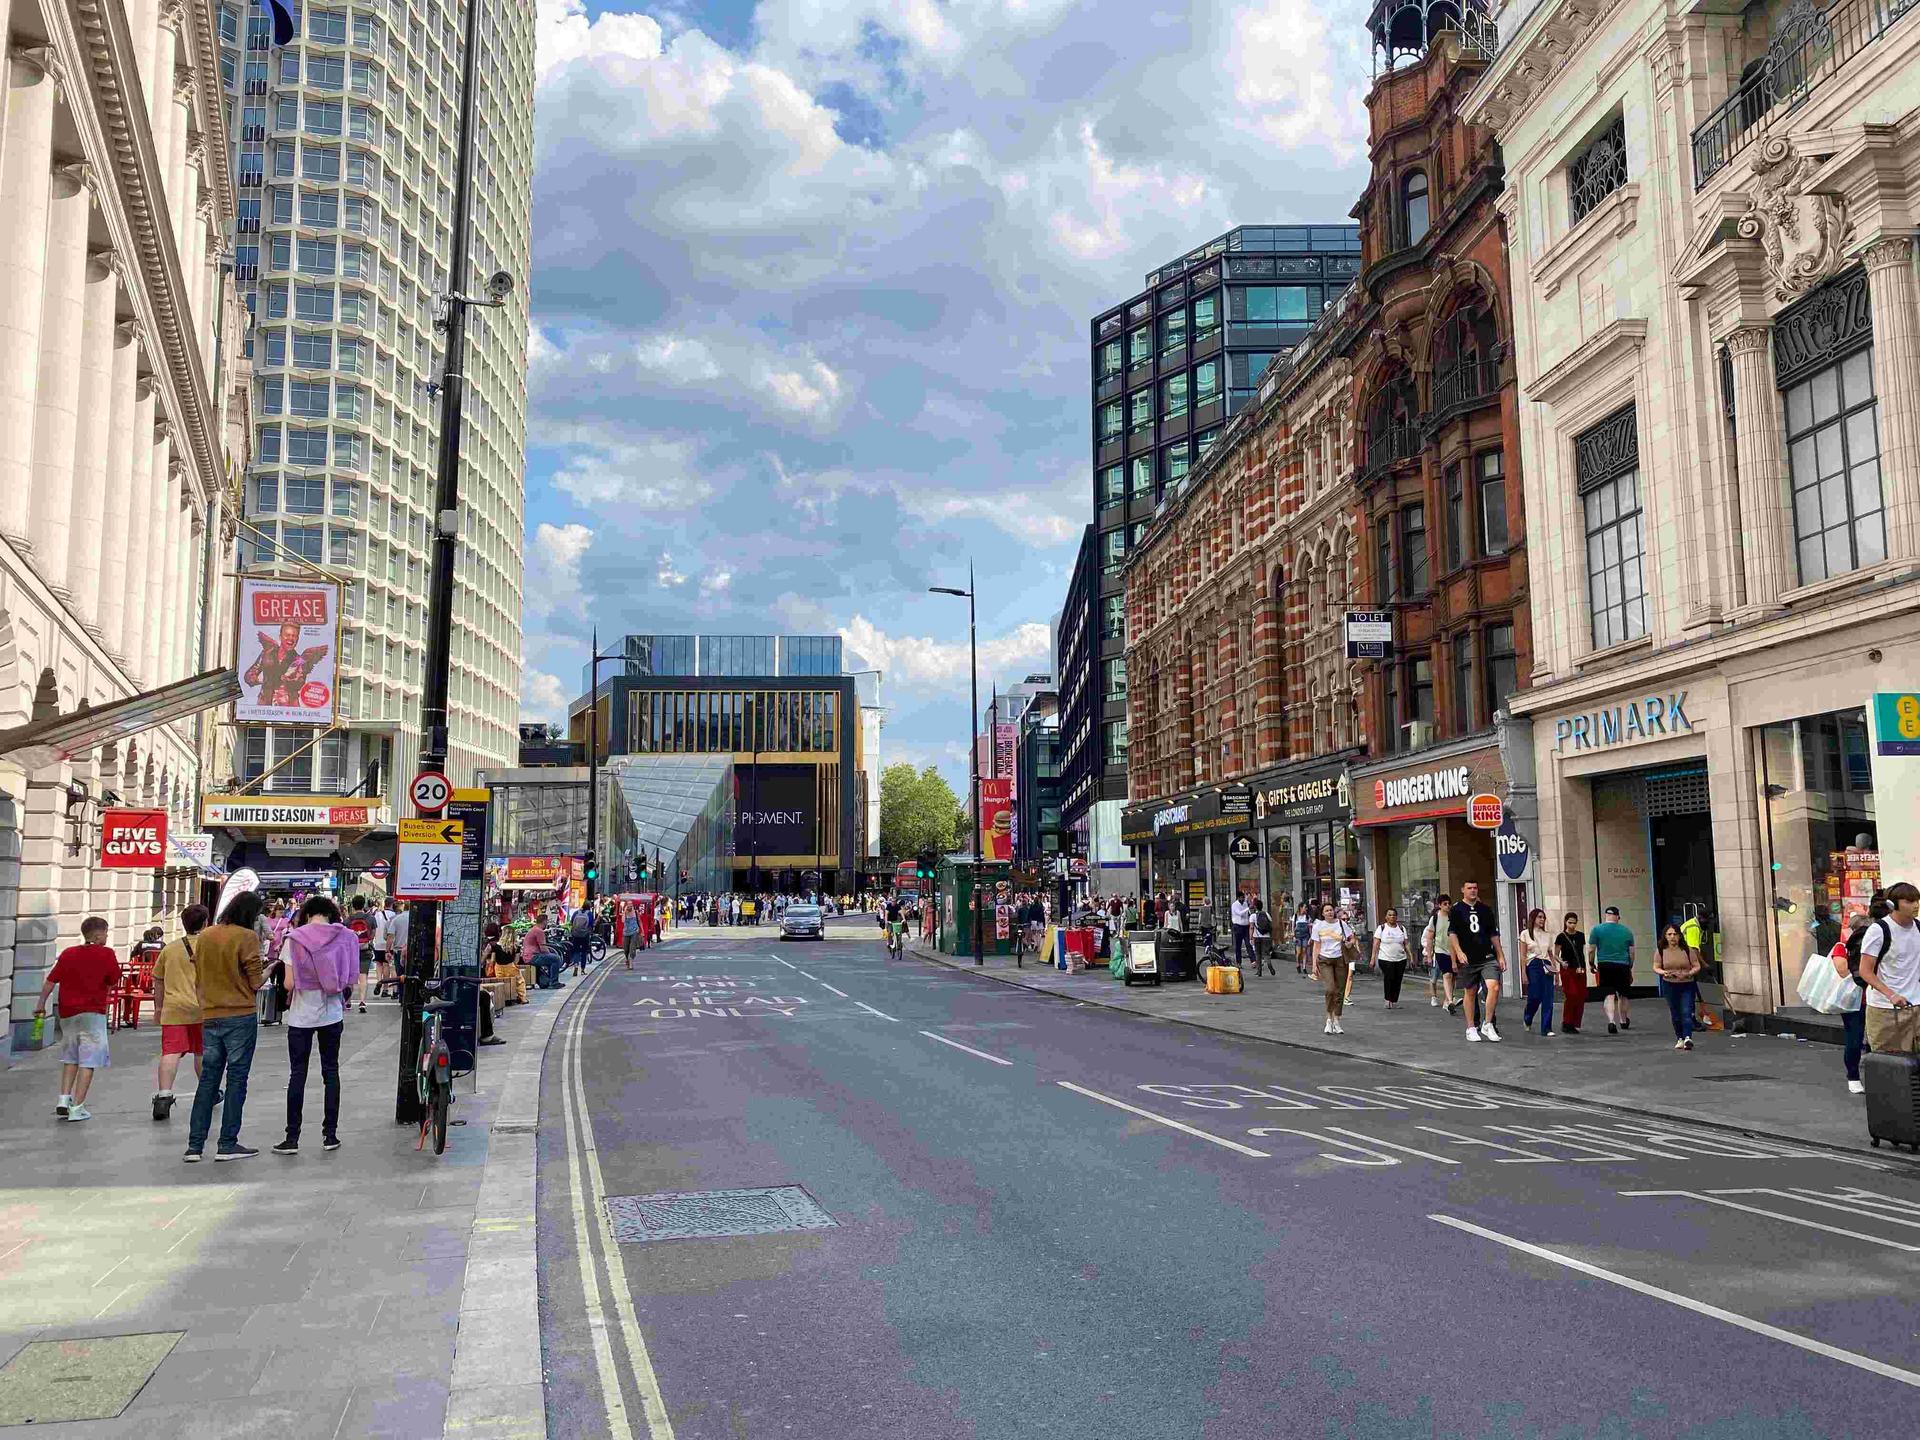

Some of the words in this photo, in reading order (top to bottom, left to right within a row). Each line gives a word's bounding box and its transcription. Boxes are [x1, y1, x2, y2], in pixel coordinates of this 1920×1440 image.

[260, 599, 322, 618] GREASE
[1353, 613, 1367, 621] TO
[1369, 613, 1385, 621] LET
[1555, 690, 1692, 752] PRIMARK
[1004, 740, 1013, 776] BROKEBACK
[416, 783, 446, 800] 20
[1268, 787, 1288, 806] GIFTS
[1290, 785, 1296, 802] &
[1297, 778, 1332, 801] GIGGLES
[1386, 774, 1433, 807] BURGER
[1434, 766, 1469, 798] KING
[984, 796, 1010, 804] Hungry?
[223, 808, 269, 822] LIMITED
[271, 808, 315, 823] SEASON
[332, 810, 366, 823] GREASE
[742, 811, 804, 825] PIGMENT.
[1473, 811, 1501, 820] KING
[112, 827, 157, 840] FIVE
[105, 841, 162, 855] GUYS
[420, 852, 442, 865] 24
[420, 867, 440, 880] 29
[1469, 914, 1480, 933] 8
[633, 996, 809, 1006] AHEAD
[650, 1006, 798, 1019] ONLY
